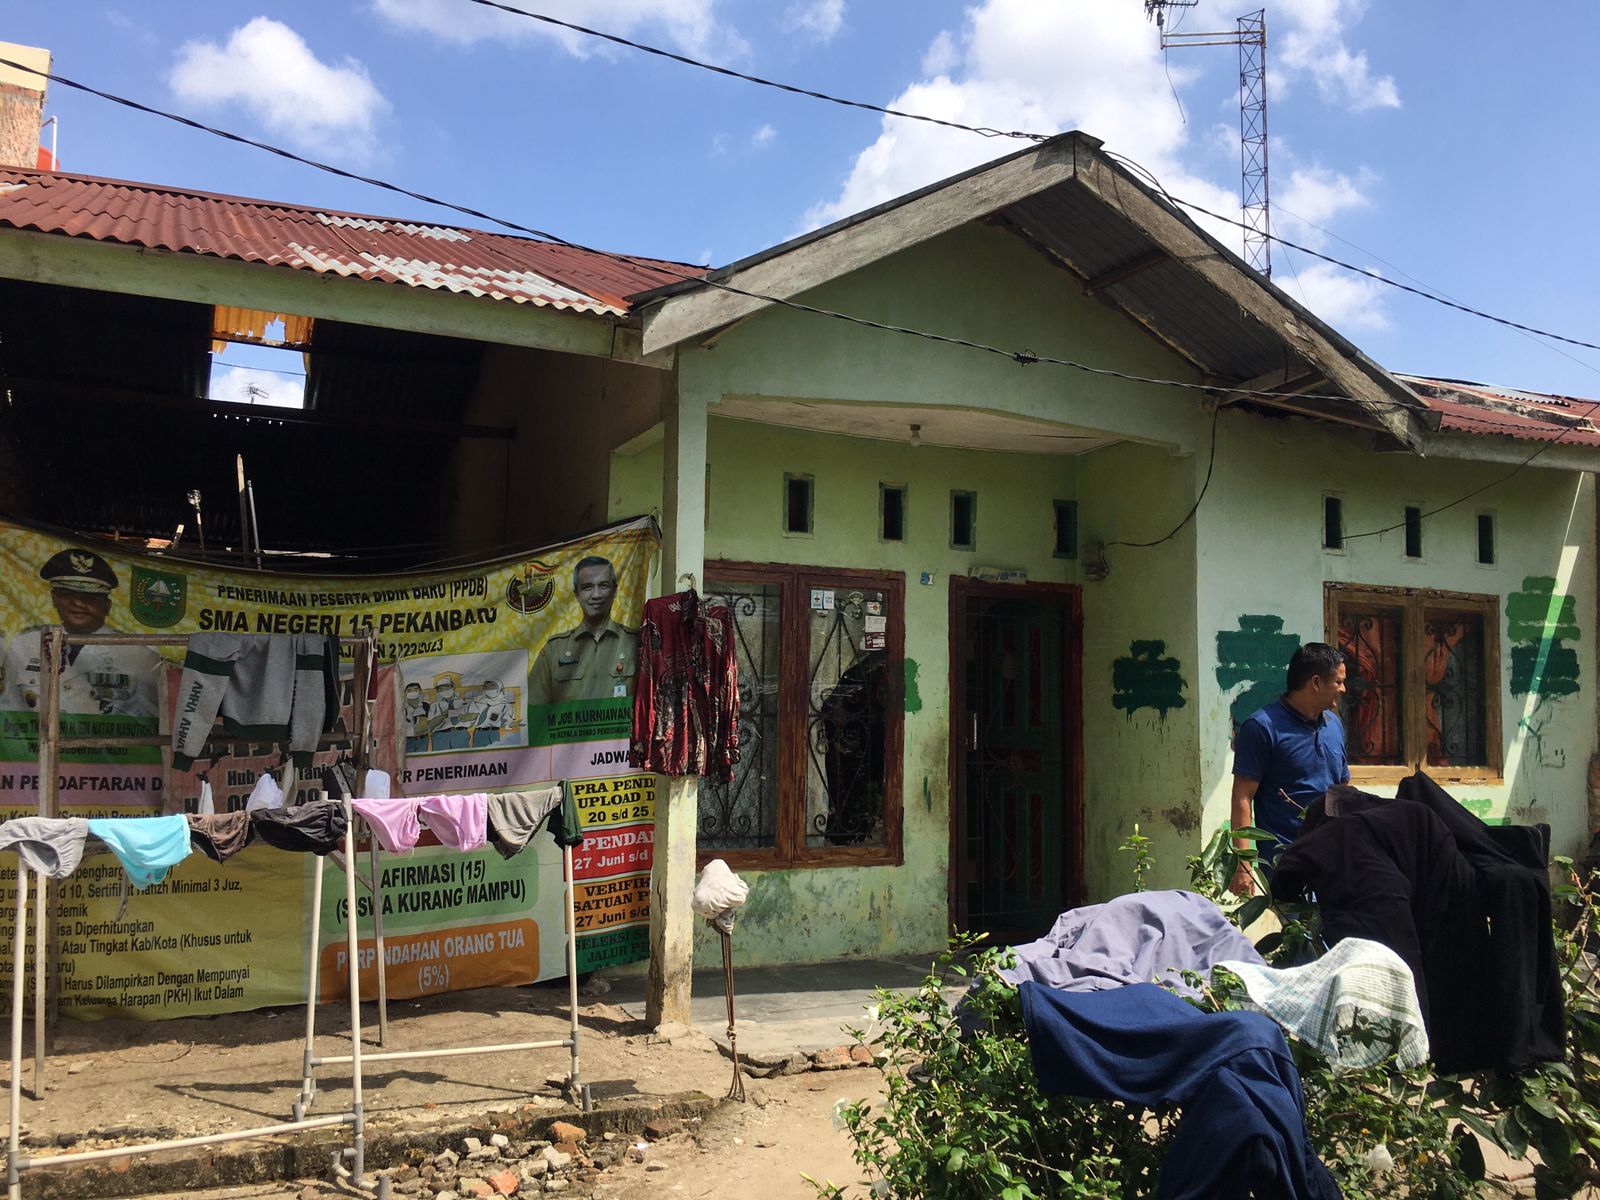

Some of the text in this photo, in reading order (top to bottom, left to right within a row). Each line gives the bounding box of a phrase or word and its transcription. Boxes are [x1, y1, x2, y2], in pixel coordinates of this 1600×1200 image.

[217, 576, 488, 607] PENERIMAAN PESERTA DIDIK BARU (PPDB)
[199, 608, 249, 632] SMA
[256, 613, 341, 636] NEGERI
[350, 614, 374, 635] 15
[575, 707, 631, 723] KURNIAWAN
[20, 775, 146, 791] PEDAFTARAN
[416, 762, 508, 782] PENERIMAAN
[574, 783, 608, 796] PRA
[577, 792, 641, 809] UPLOAD
[588, 806, 649, 823] 20 s/d 25
[574, 849, 648, 870] 27 Juni s/d
[380, 859, 486, 888] AFIRMASI (15)
[70, 885, 85, 900] 10,
[88, 883, 134, 898] Sertifiat
[137, 880, 168, 896] afizh
[172, 879, 211, 894] Minimal
[214, 879, 220, 892] 3
[222, 878, 243, 893] Juz,
[398, 888, 463, 913] KURANG
[467, 879, 526, 905] MAMPU)
[584, 877, 650, 897] VERIFIK
[574, 892, 633, 912] SATUAN
[575, 906, 650, 928] 27 Juni s/d
[75, 919, 154, 938] Diperhitungkan
[61, 940, 86, 954] Atau
[89, 938, 128, 955] Tingkat
[131, 935, 177, 952] Kab/Kota
[180, 933, 221, 952] (Khusus
[224, 929, 252, 944] untuk
[444, 933, 494, 957] ORANG
[498, 928, 525, 950] TUA
[64, 977, 94, 991] Harus
[96, 973, 154, 991] Dilampirkan
[157, 971, 194, 987] Dengan
[197, 965, 250, 984] Mempunyai
[418, 964, 449, 992] (5%)
[120, 992, 161, 1009] Harapan
[163, 989, 192, 1008] (PKH)
[194, 986, 212, 1001] Ikut
[214, 985, 244, 999] Dalam
